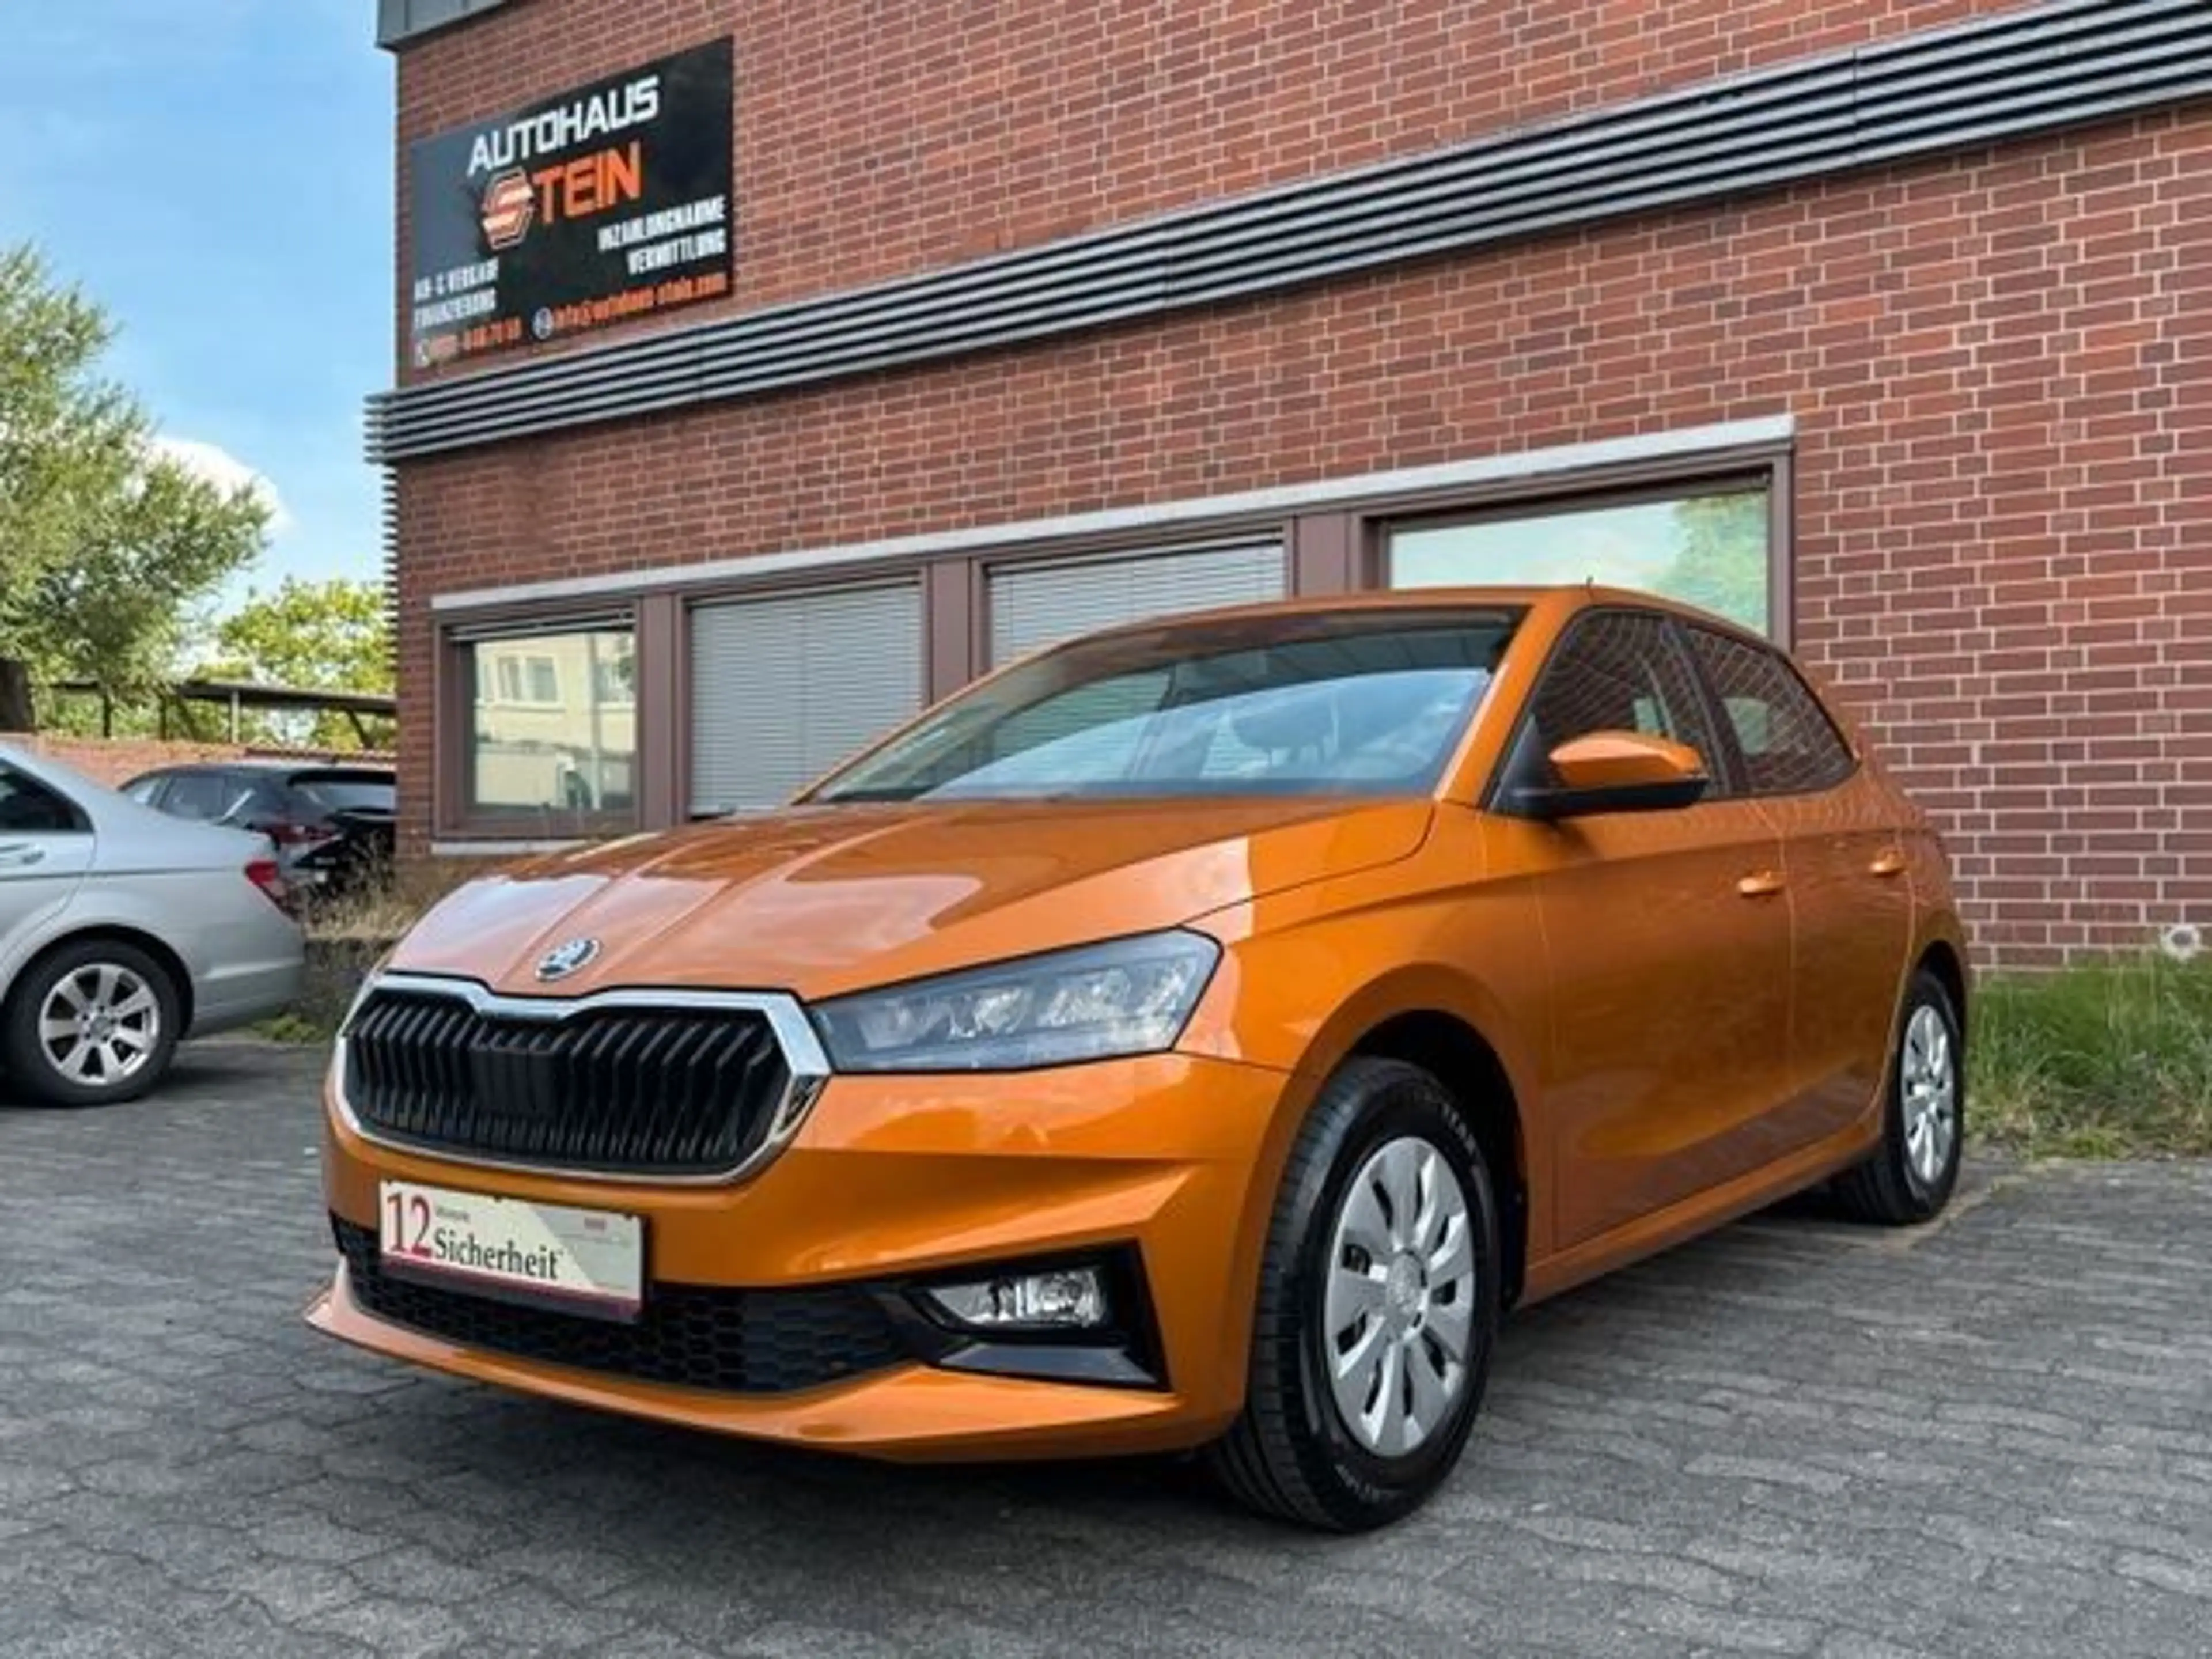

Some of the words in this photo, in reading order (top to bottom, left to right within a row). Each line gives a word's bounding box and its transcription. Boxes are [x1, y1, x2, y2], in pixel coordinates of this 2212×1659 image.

[467, 74, 661, 177] AUTOHAUS
[387, 1192, 432, 1257] 12
[434, 1228, 560, 1280] Sicherheit
